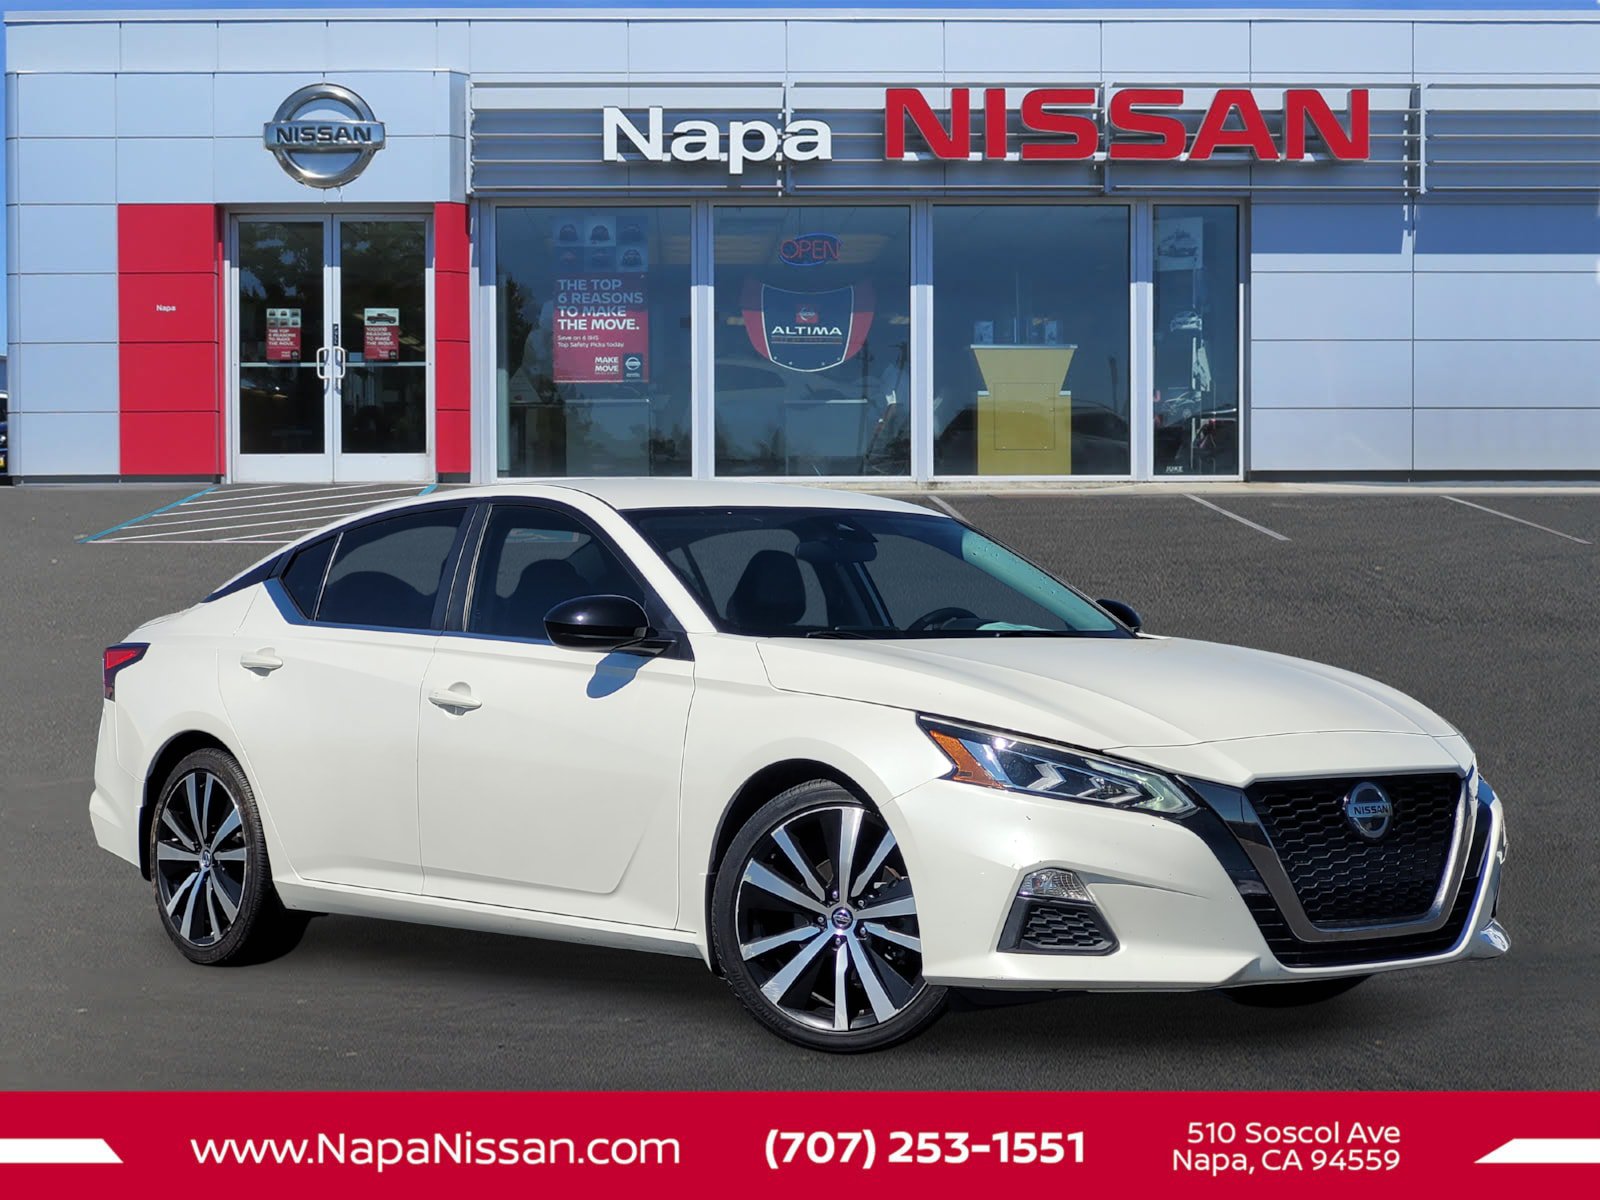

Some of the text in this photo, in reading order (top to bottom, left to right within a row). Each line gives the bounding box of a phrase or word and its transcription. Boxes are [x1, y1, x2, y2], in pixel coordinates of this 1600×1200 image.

[275, 126, 372, 143] NISSAN
[602, 88, 1369, 174] Napa NISSAN
[780, 239, 841, 260] OPEN
[557, 279, 622, 291] THE TOP
[558, 292, 643, 304] 6 REASONS
[156, 304, 176, 312] Napa
[557, 305, 626, 317] TO MAKE
[557, 319, 640, 330] THE MOVE.
[771, 326, 842, 335] ALTIMA
[1353, 805, 1389, 815] NISSAN
